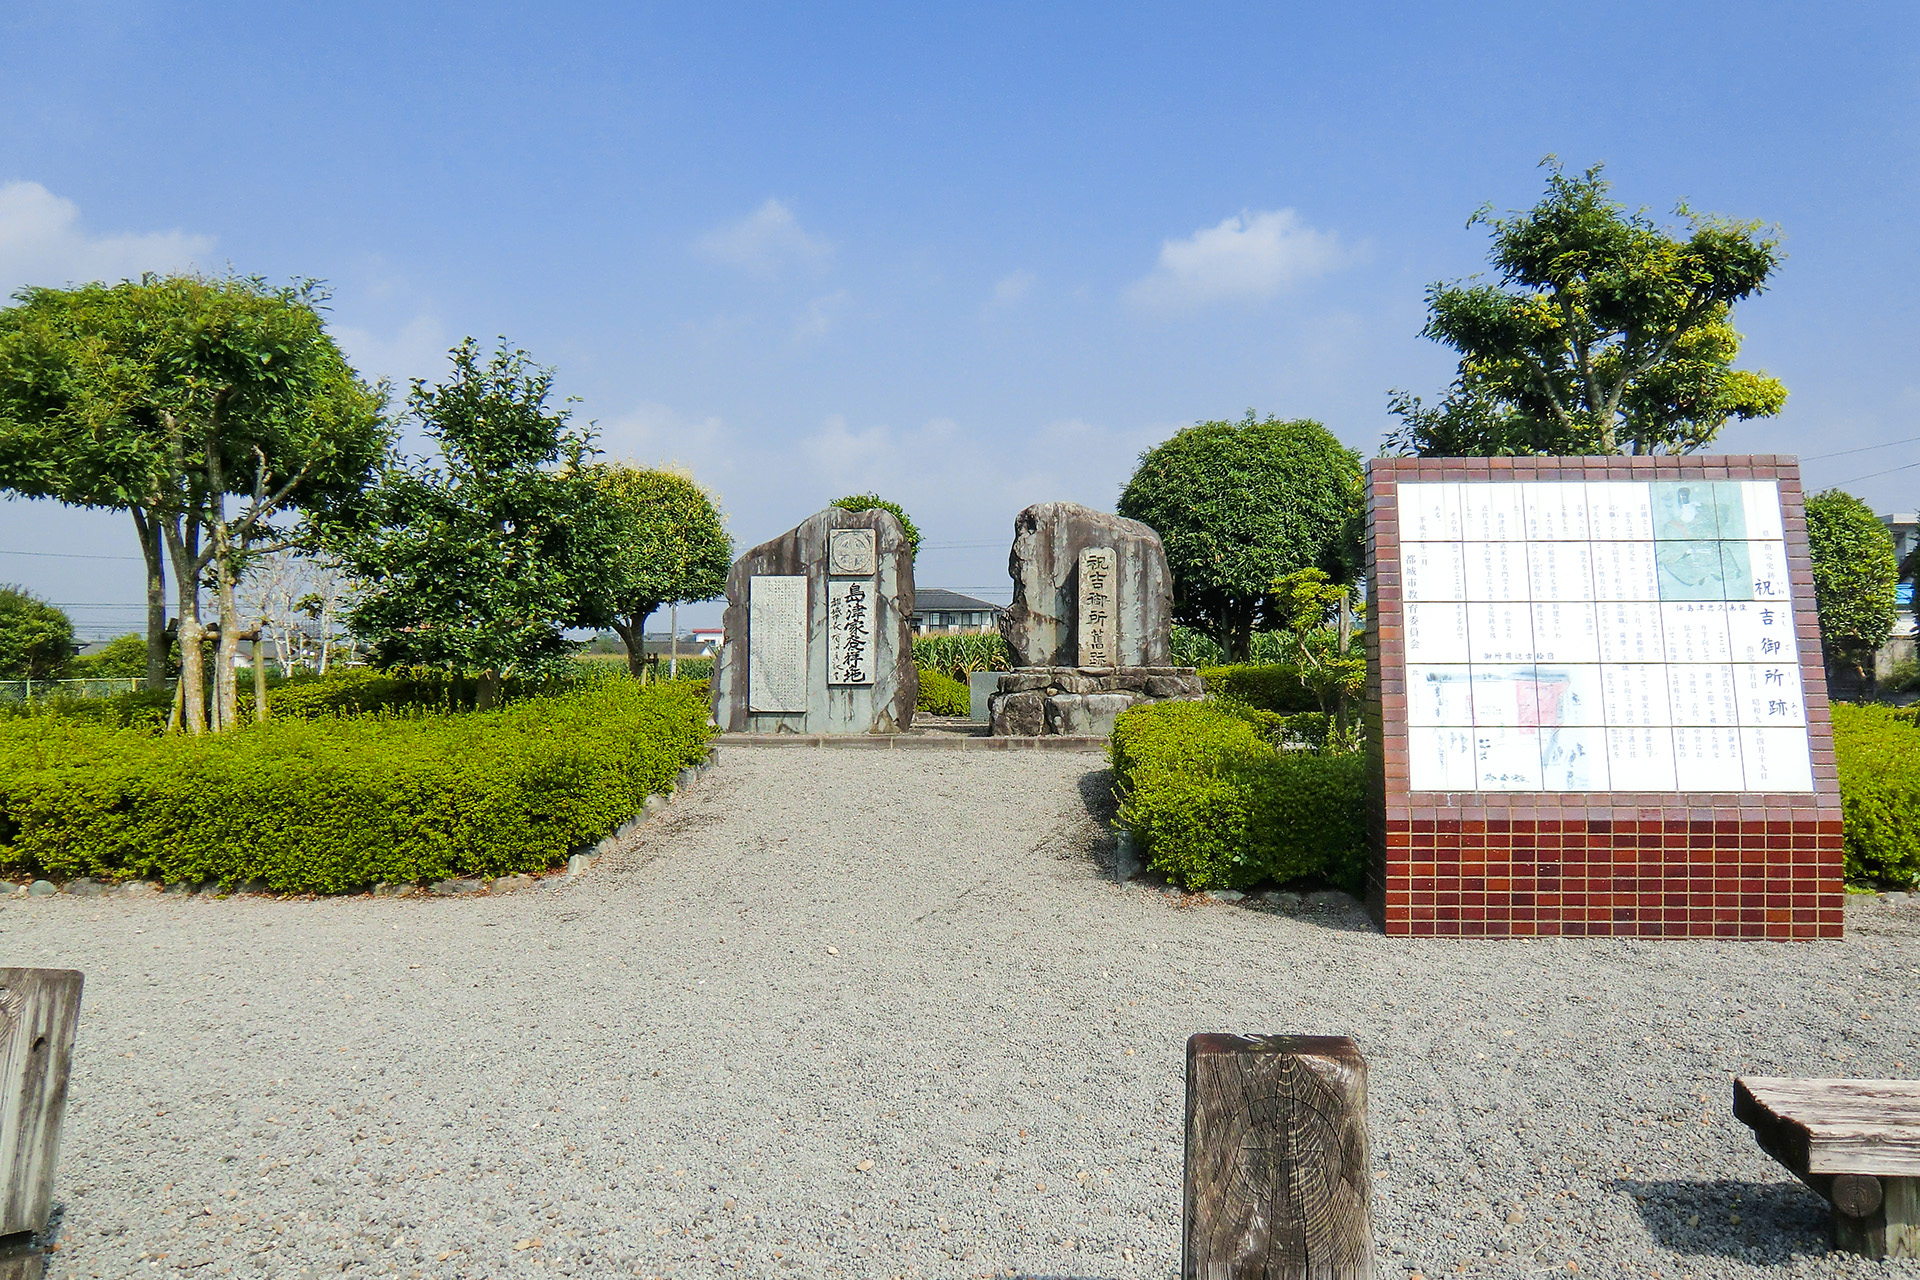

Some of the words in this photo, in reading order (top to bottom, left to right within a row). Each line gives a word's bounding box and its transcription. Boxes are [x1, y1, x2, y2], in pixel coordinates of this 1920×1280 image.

[1406, 554, 1420, 650] 都城市教育委員会
[1754, 578, 1788, 717] 祝吉御所跡
